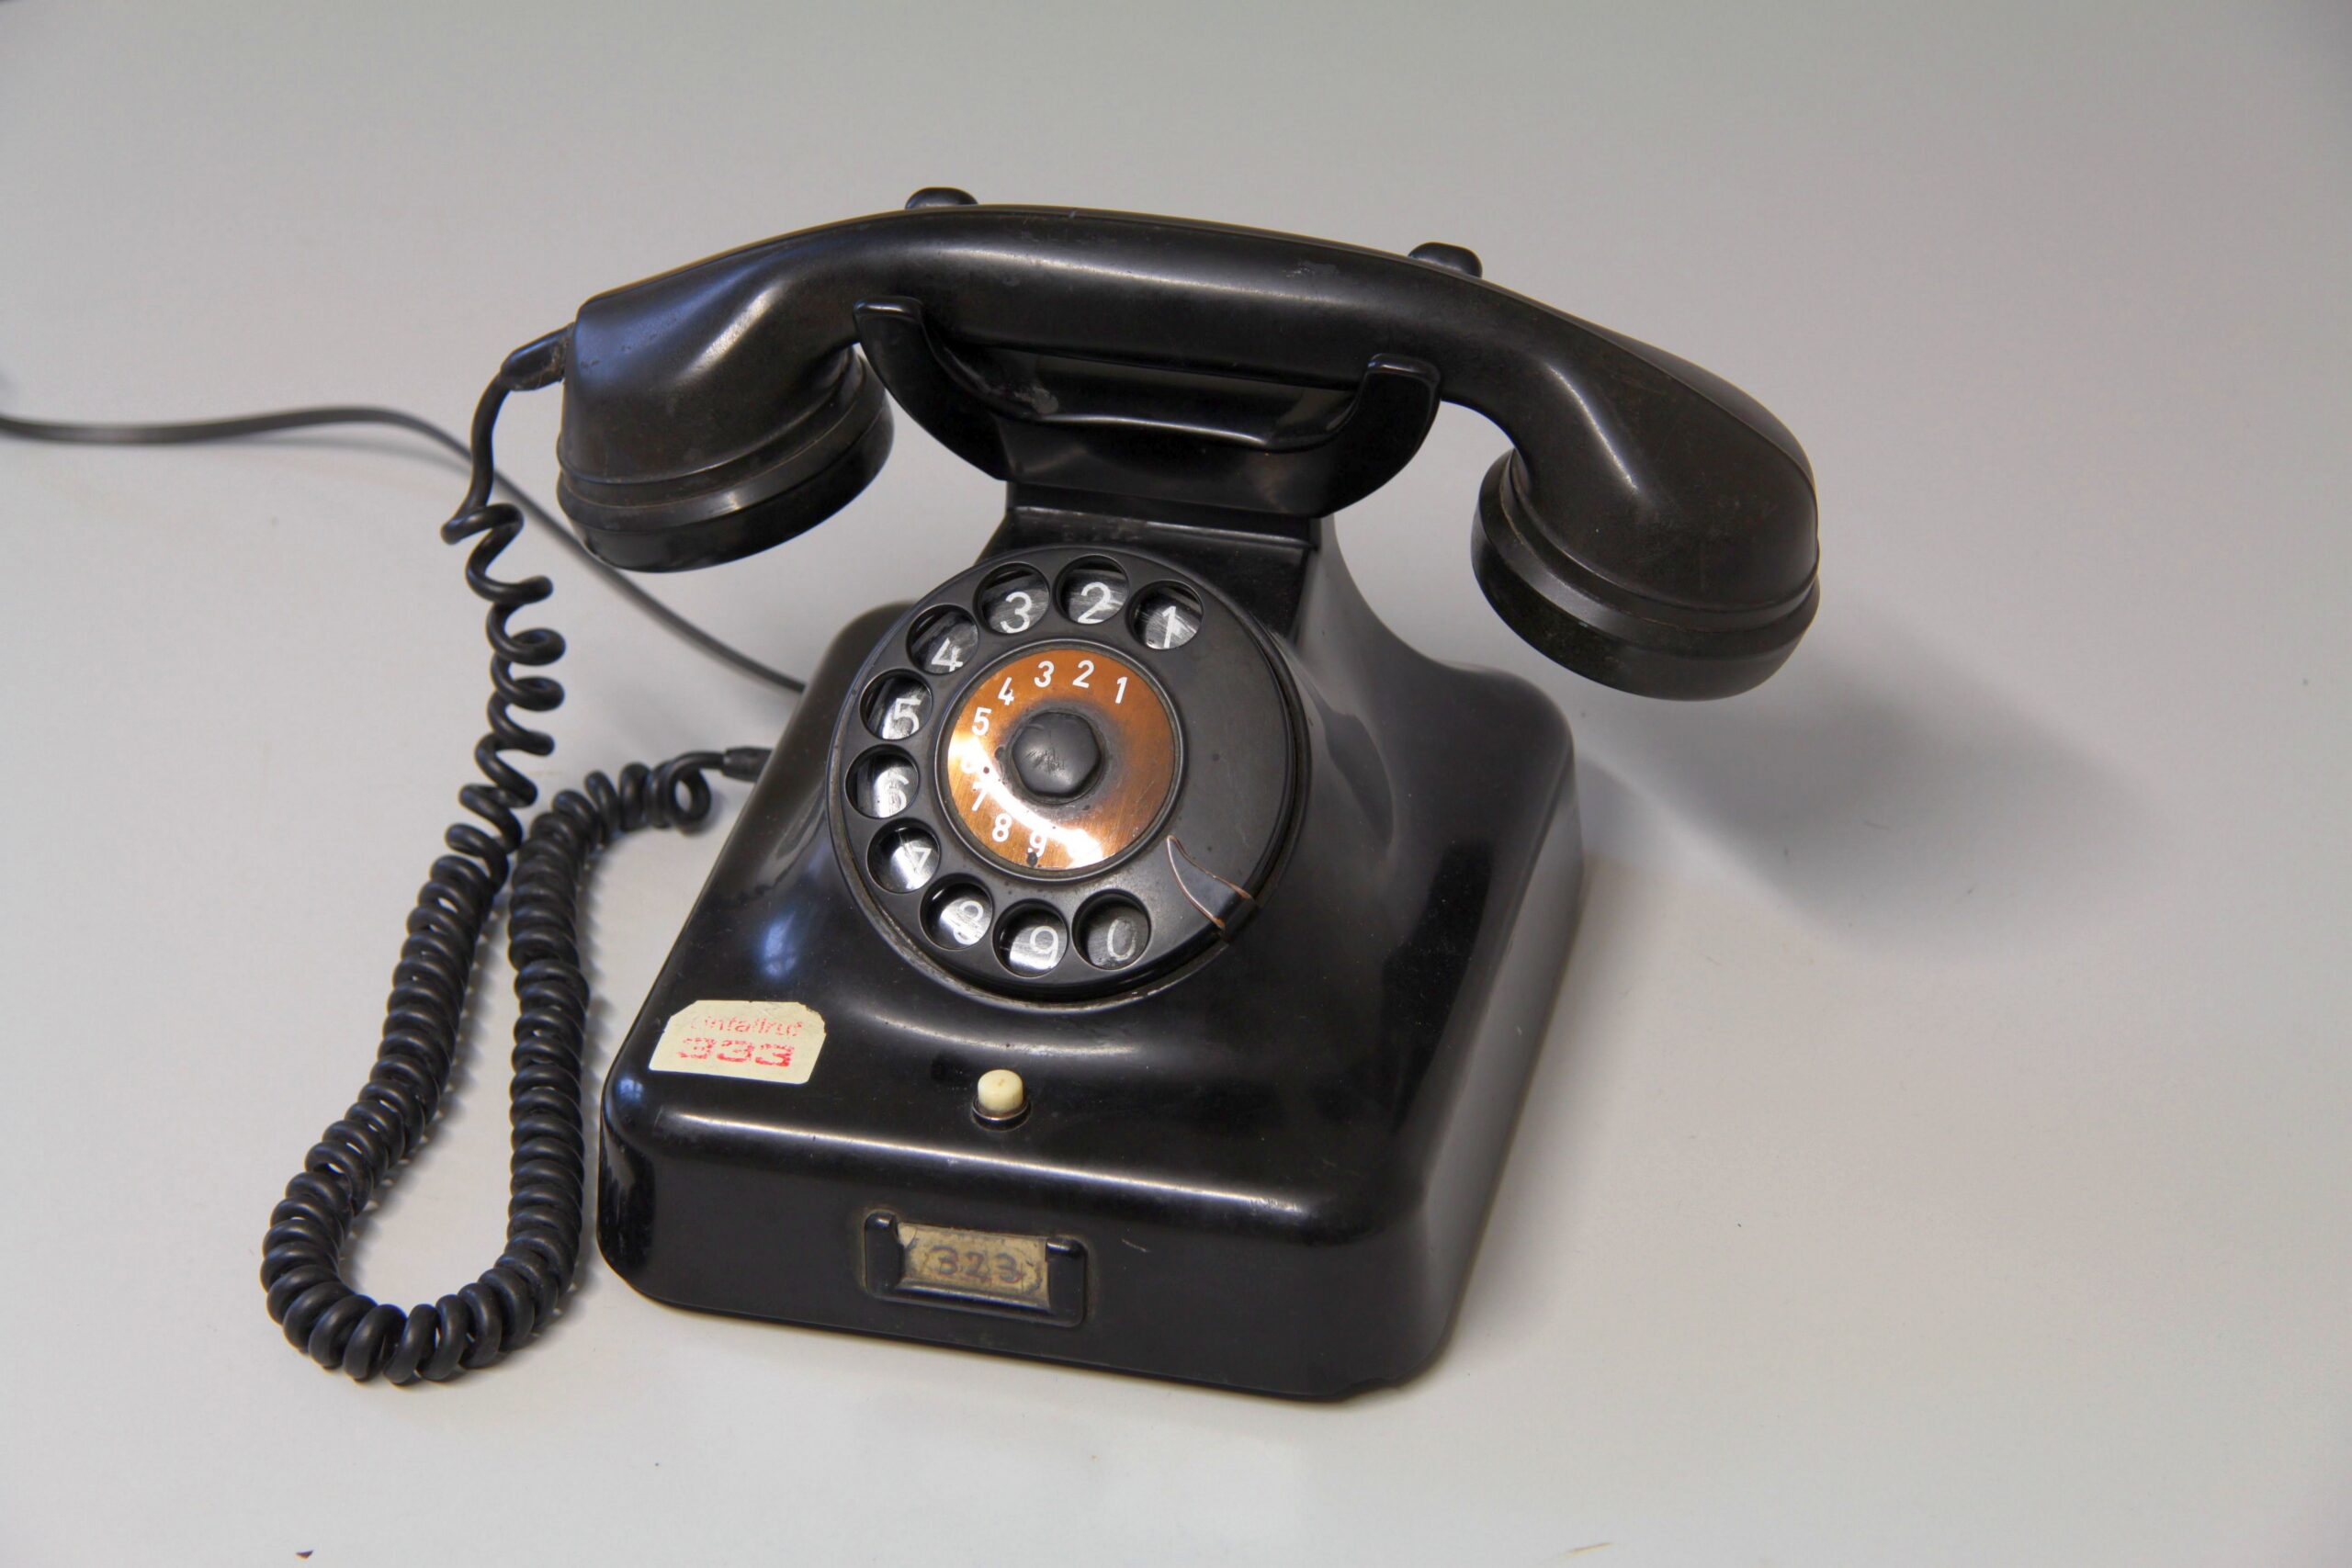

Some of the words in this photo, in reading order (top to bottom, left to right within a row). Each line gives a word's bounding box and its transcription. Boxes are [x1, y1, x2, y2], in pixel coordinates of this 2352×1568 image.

[1001, 592, 1033, 633] 3
[1079, 581, 1111, 625] 2
[1162, 605, 1177, 649] 1
[931, 637, 964, 673] 4
[998, 676, 1015, 705] 4
[1034, 660, 1055, 688] 3
[1073, 660, 1094, 688] 2
[1114, 676, 1128, 705] 1
[890, 697, 922, 738] 5
[971, 706, 992, 736] 5
[884, 773, 910, 813] 6
[971, 782, 990, 812] 7
[992, 813, 1012, 842] 8
[1027, 829, 1047, 858] 9
[953, 900, 984, 945] 8
[1029, 925, 1058, 968] 9
[930, 1245, 1023, 1283] 323
